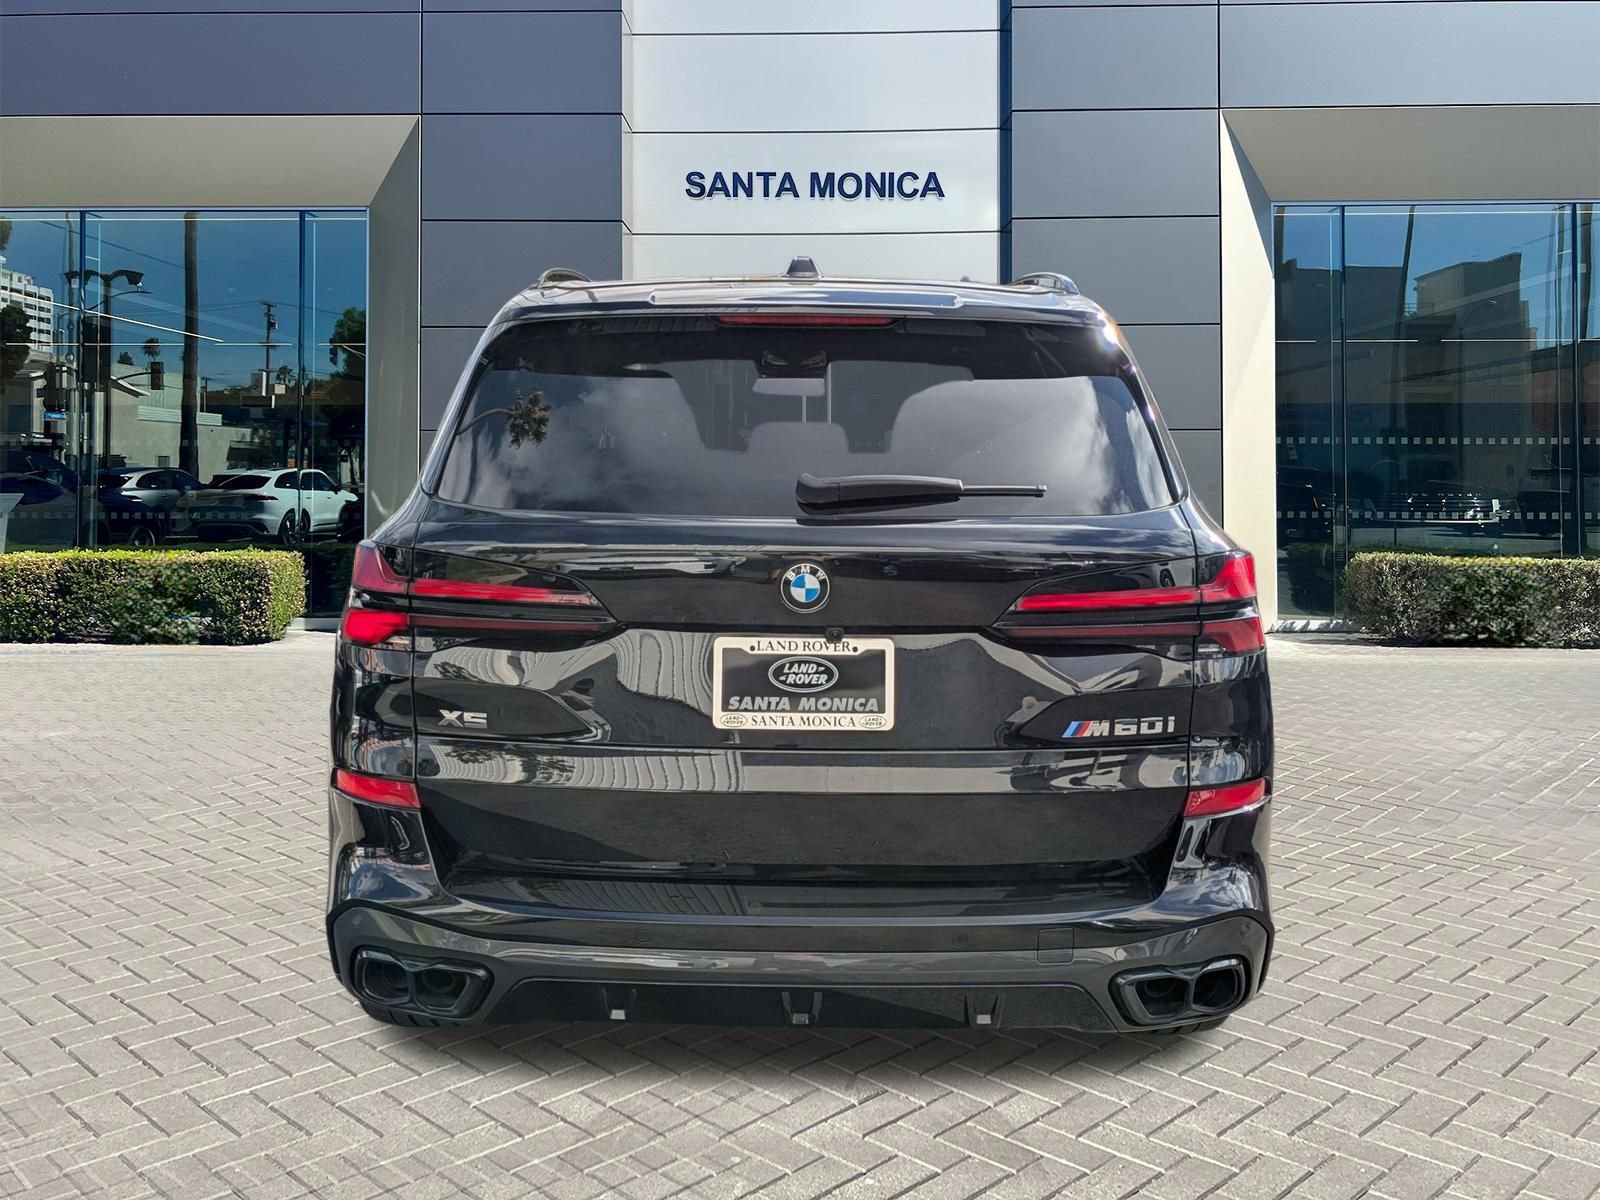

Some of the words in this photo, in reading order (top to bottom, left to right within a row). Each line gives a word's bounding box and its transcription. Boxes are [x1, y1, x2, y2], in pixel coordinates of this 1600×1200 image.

[685, 171, 800, 199] SANTA
[809, 171, 945, 199] MONICA
[757, 640, 799, 652] LAND
[802, 640, 851, 652] ROVER
[783, 663, 817, 674] LAND
[786, 674, 828, 685] ROVER
[728, 695, 791, 711] SANTA
[798, 697, 879, 712] MONICA
[438, 709, 488, 729] X5
[751, 715, 795, 727] SANTA
[799, 716, 856, 728] MONICA
